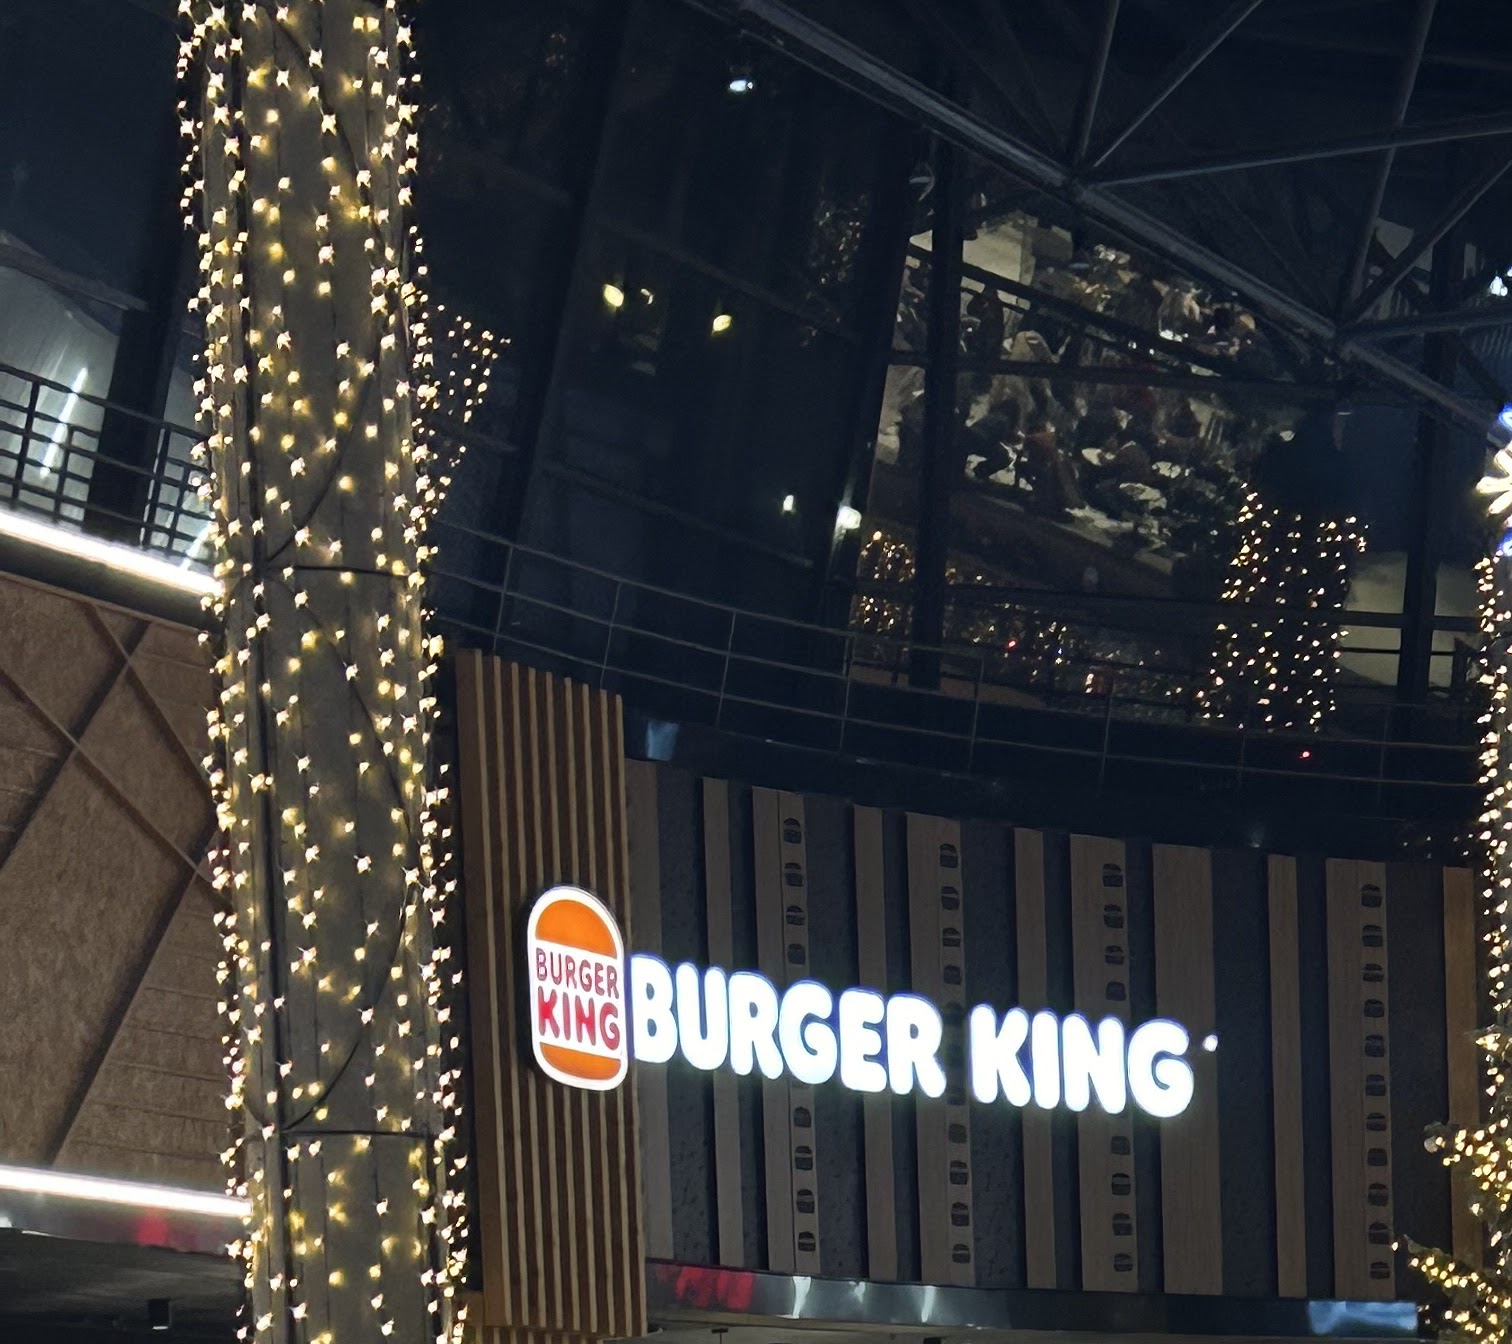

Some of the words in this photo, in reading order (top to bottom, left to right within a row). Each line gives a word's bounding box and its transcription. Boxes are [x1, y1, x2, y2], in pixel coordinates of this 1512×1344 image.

[535, 947, 620, 1000] BURGER
[537, 985, 621, 1051] KING
[630, 954, 947, 1098] BURGER
[968, 1003, 1195, 1118] KING
